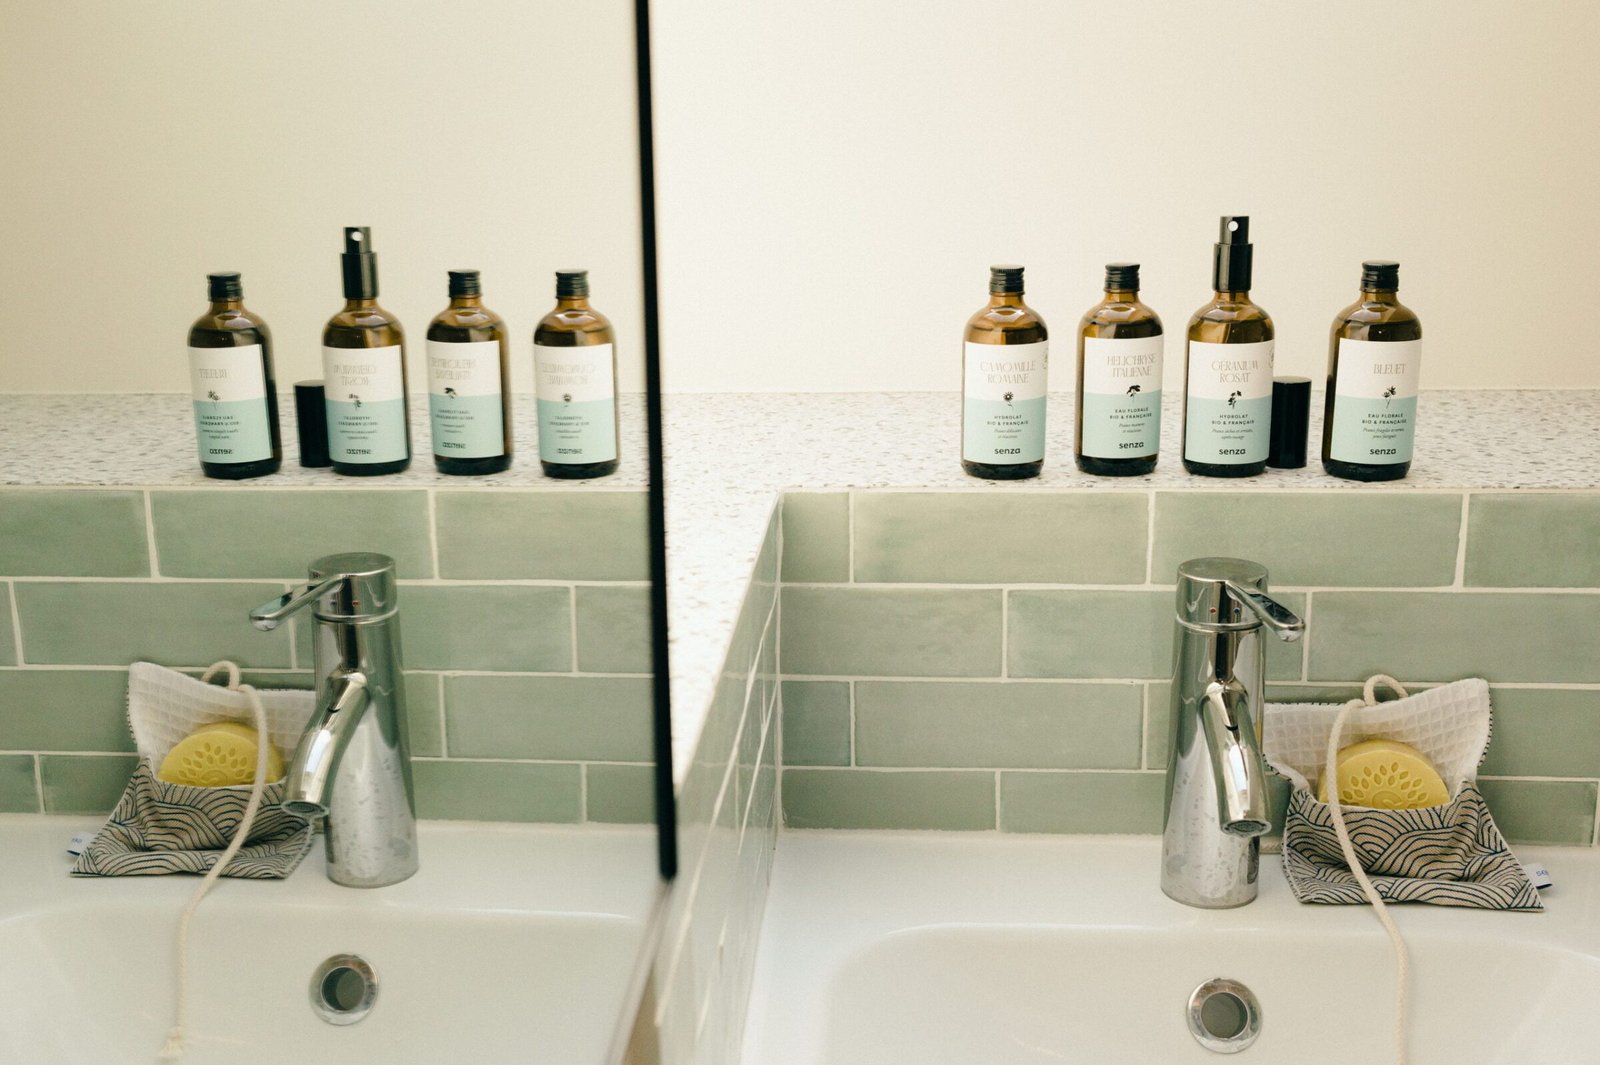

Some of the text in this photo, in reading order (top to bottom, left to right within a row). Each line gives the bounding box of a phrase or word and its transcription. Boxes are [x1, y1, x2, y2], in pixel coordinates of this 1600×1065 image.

[980, 360, 1036, 372] CAMOMILLE
[1373, 364, 1406, 374] BLEUET
[1112, 366, 1152, 378] ITALIENNE
[1219, 372, 1251, 382] ROSAT
[988, 373, 1029, 384] ROMAINE
